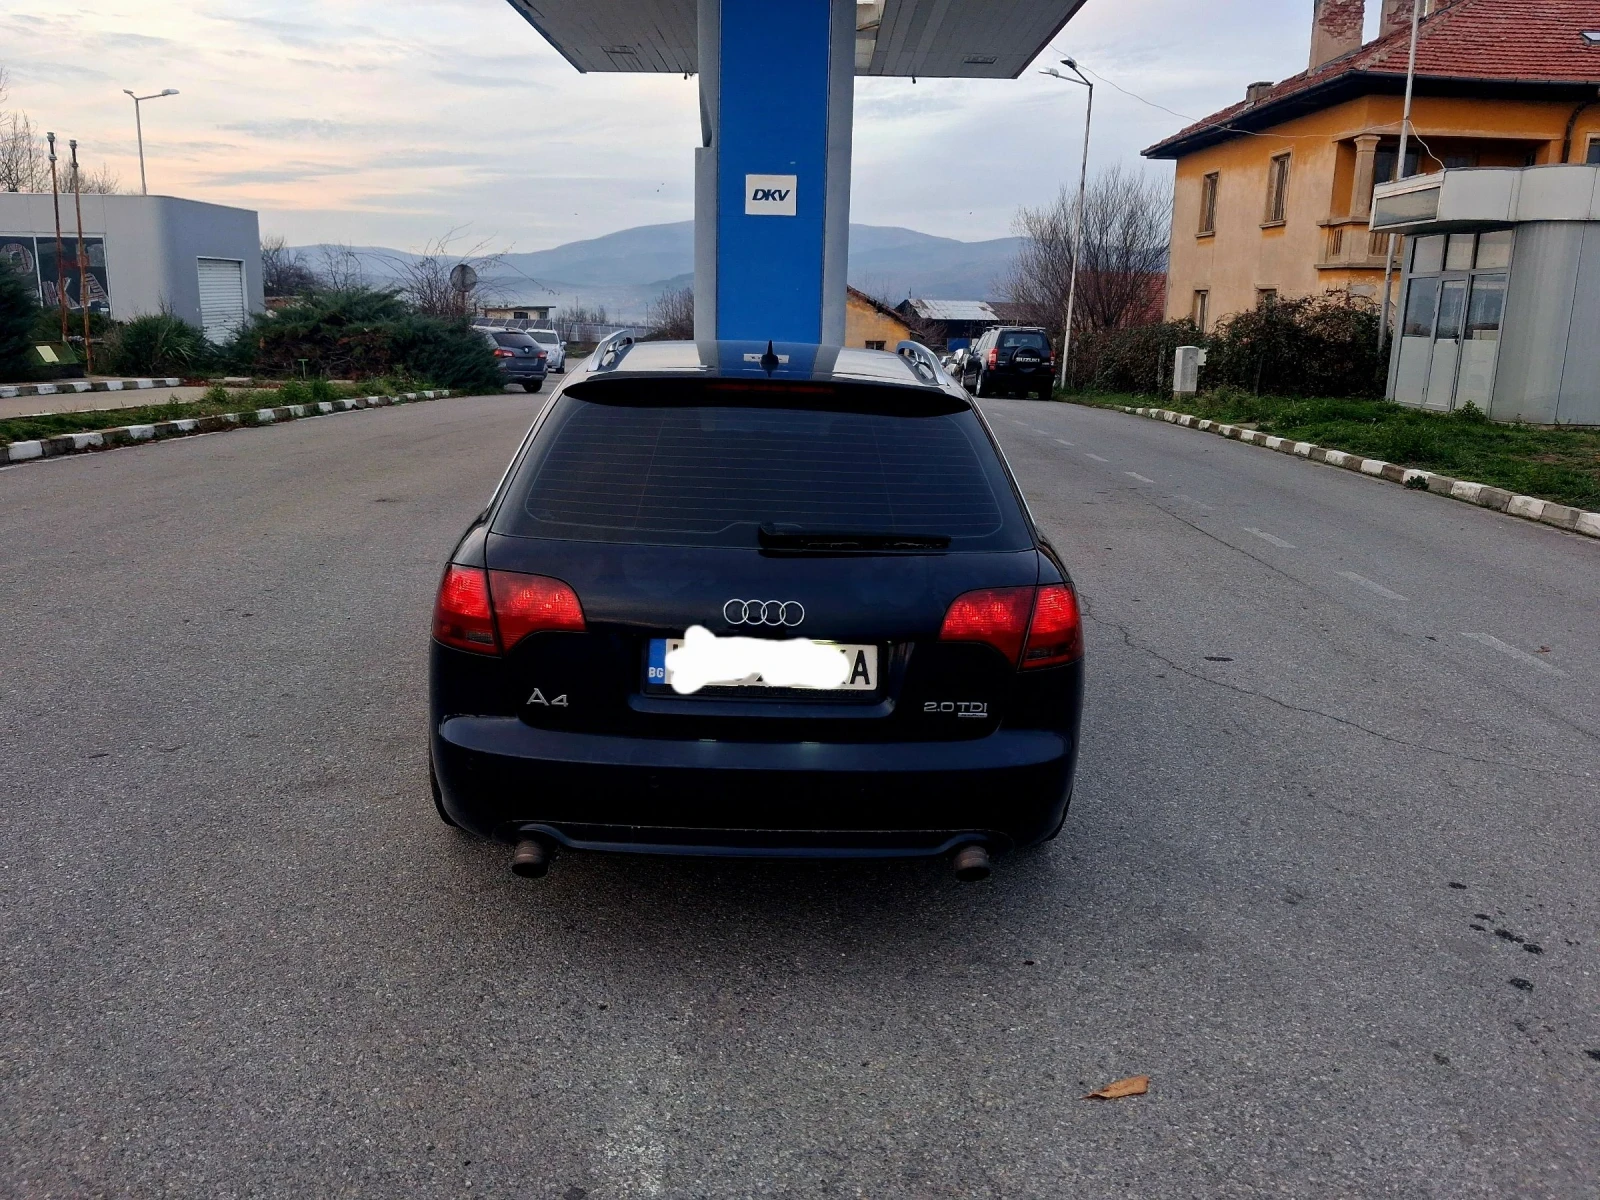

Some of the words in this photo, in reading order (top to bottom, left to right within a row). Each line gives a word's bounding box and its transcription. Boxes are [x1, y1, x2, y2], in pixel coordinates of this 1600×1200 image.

[752, 189, 790, 201] DKV
[649, 666, 664, 678] BG
[526, 687, 569, 707] A4
